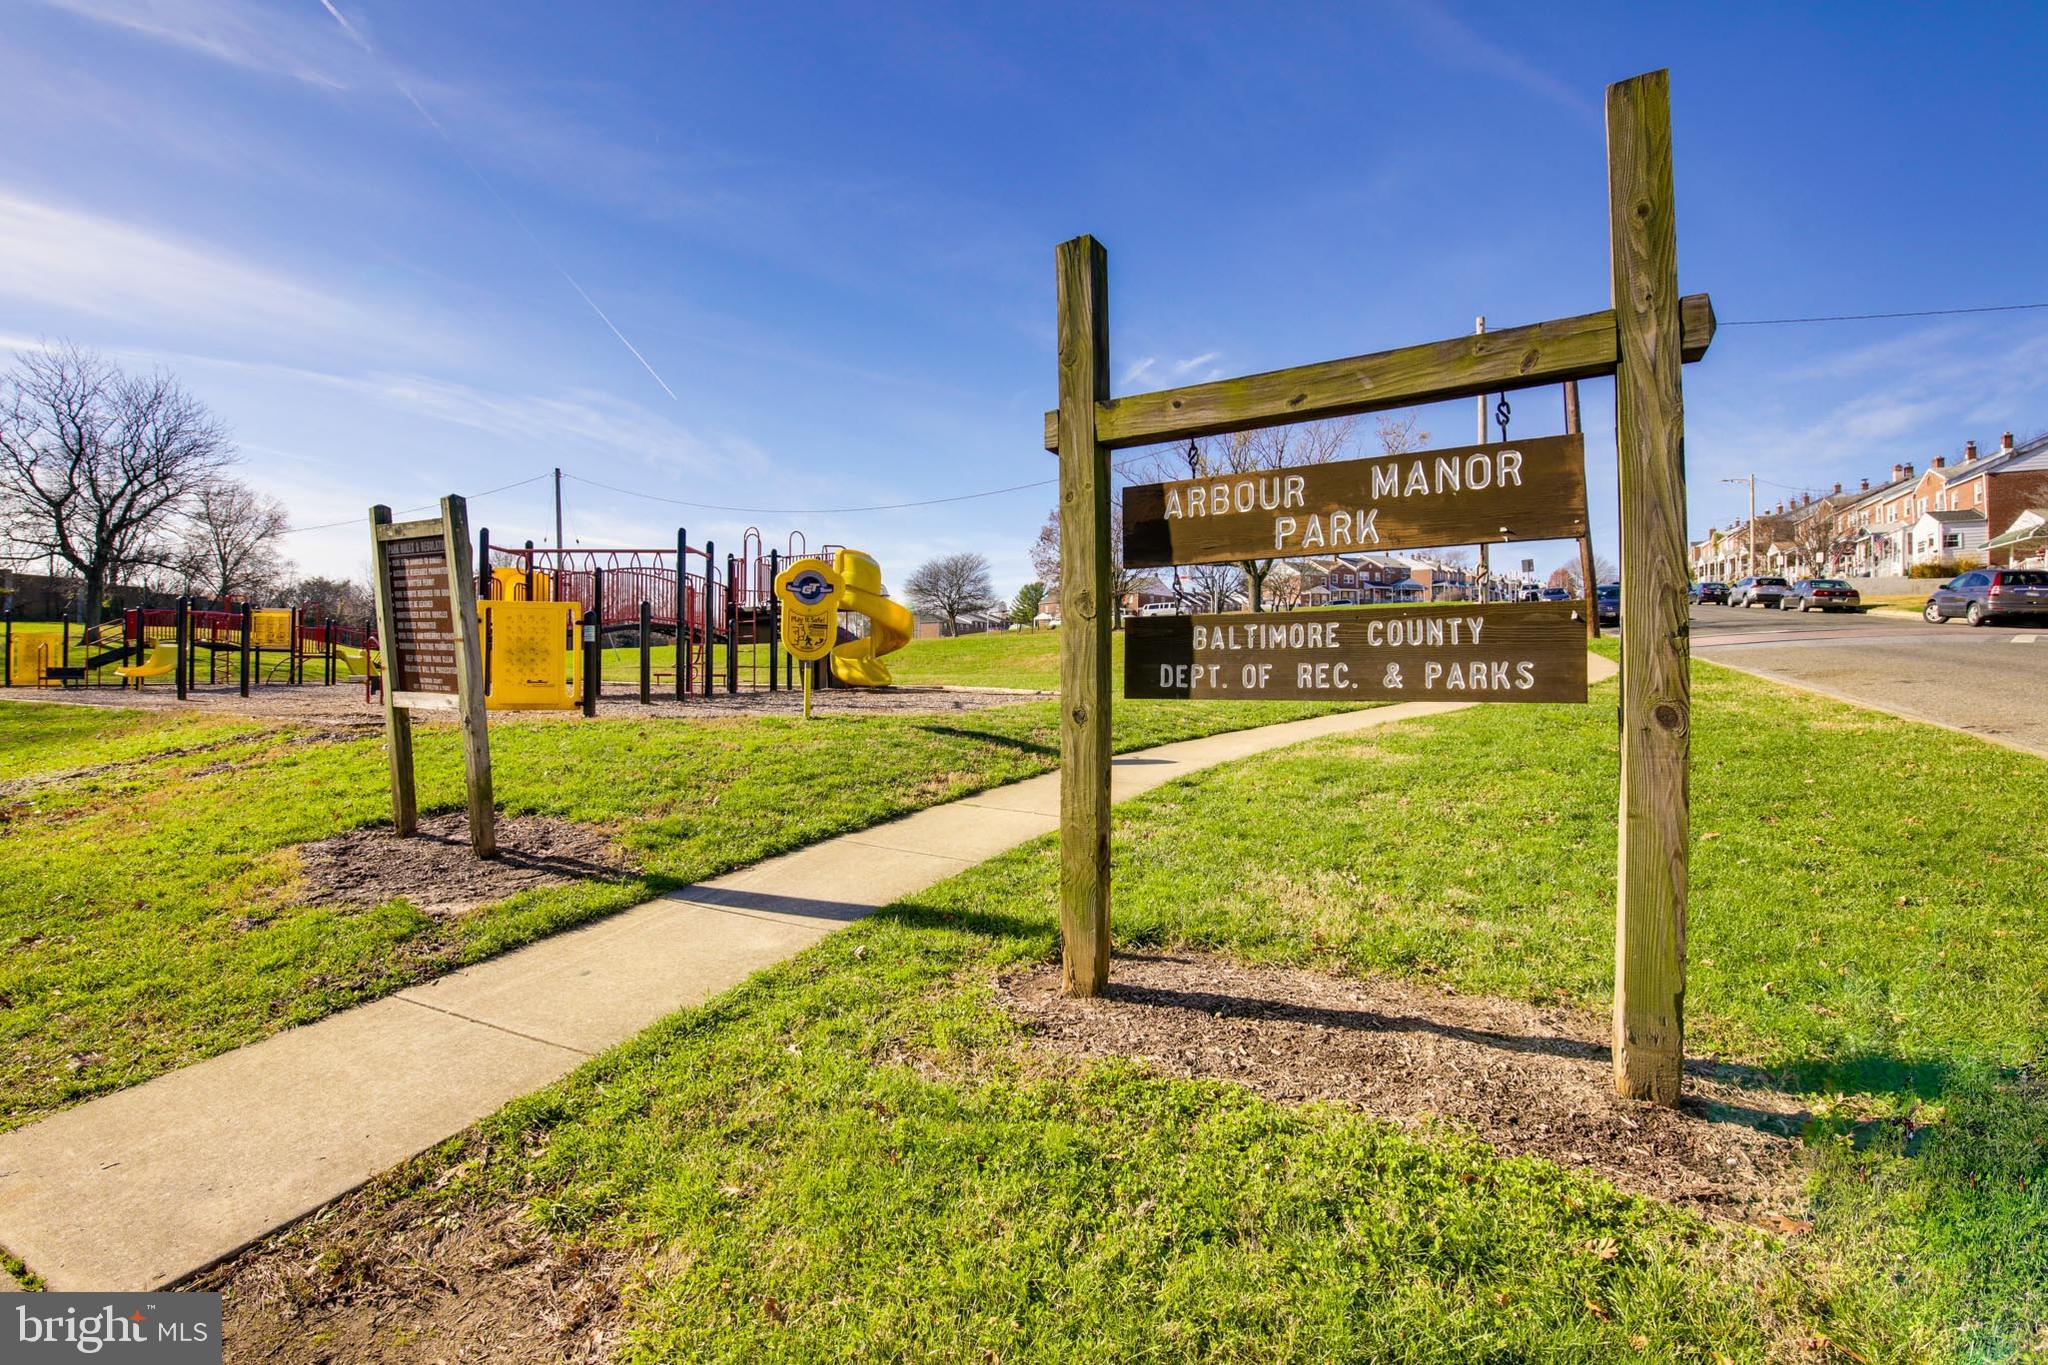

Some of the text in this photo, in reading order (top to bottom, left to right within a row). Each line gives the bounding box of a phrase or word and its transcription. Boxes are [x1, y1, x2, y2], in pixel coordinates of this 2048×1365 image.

[1164, 450, 1523, 520] ARBOUR MANOR
[1275, 508, 1380, 550] PARK
[1193, 616, 1484, 650] BALTIMORE COUNTY
[1160, 661, 1535, 690] DEPT. OF REC. & PARKS
